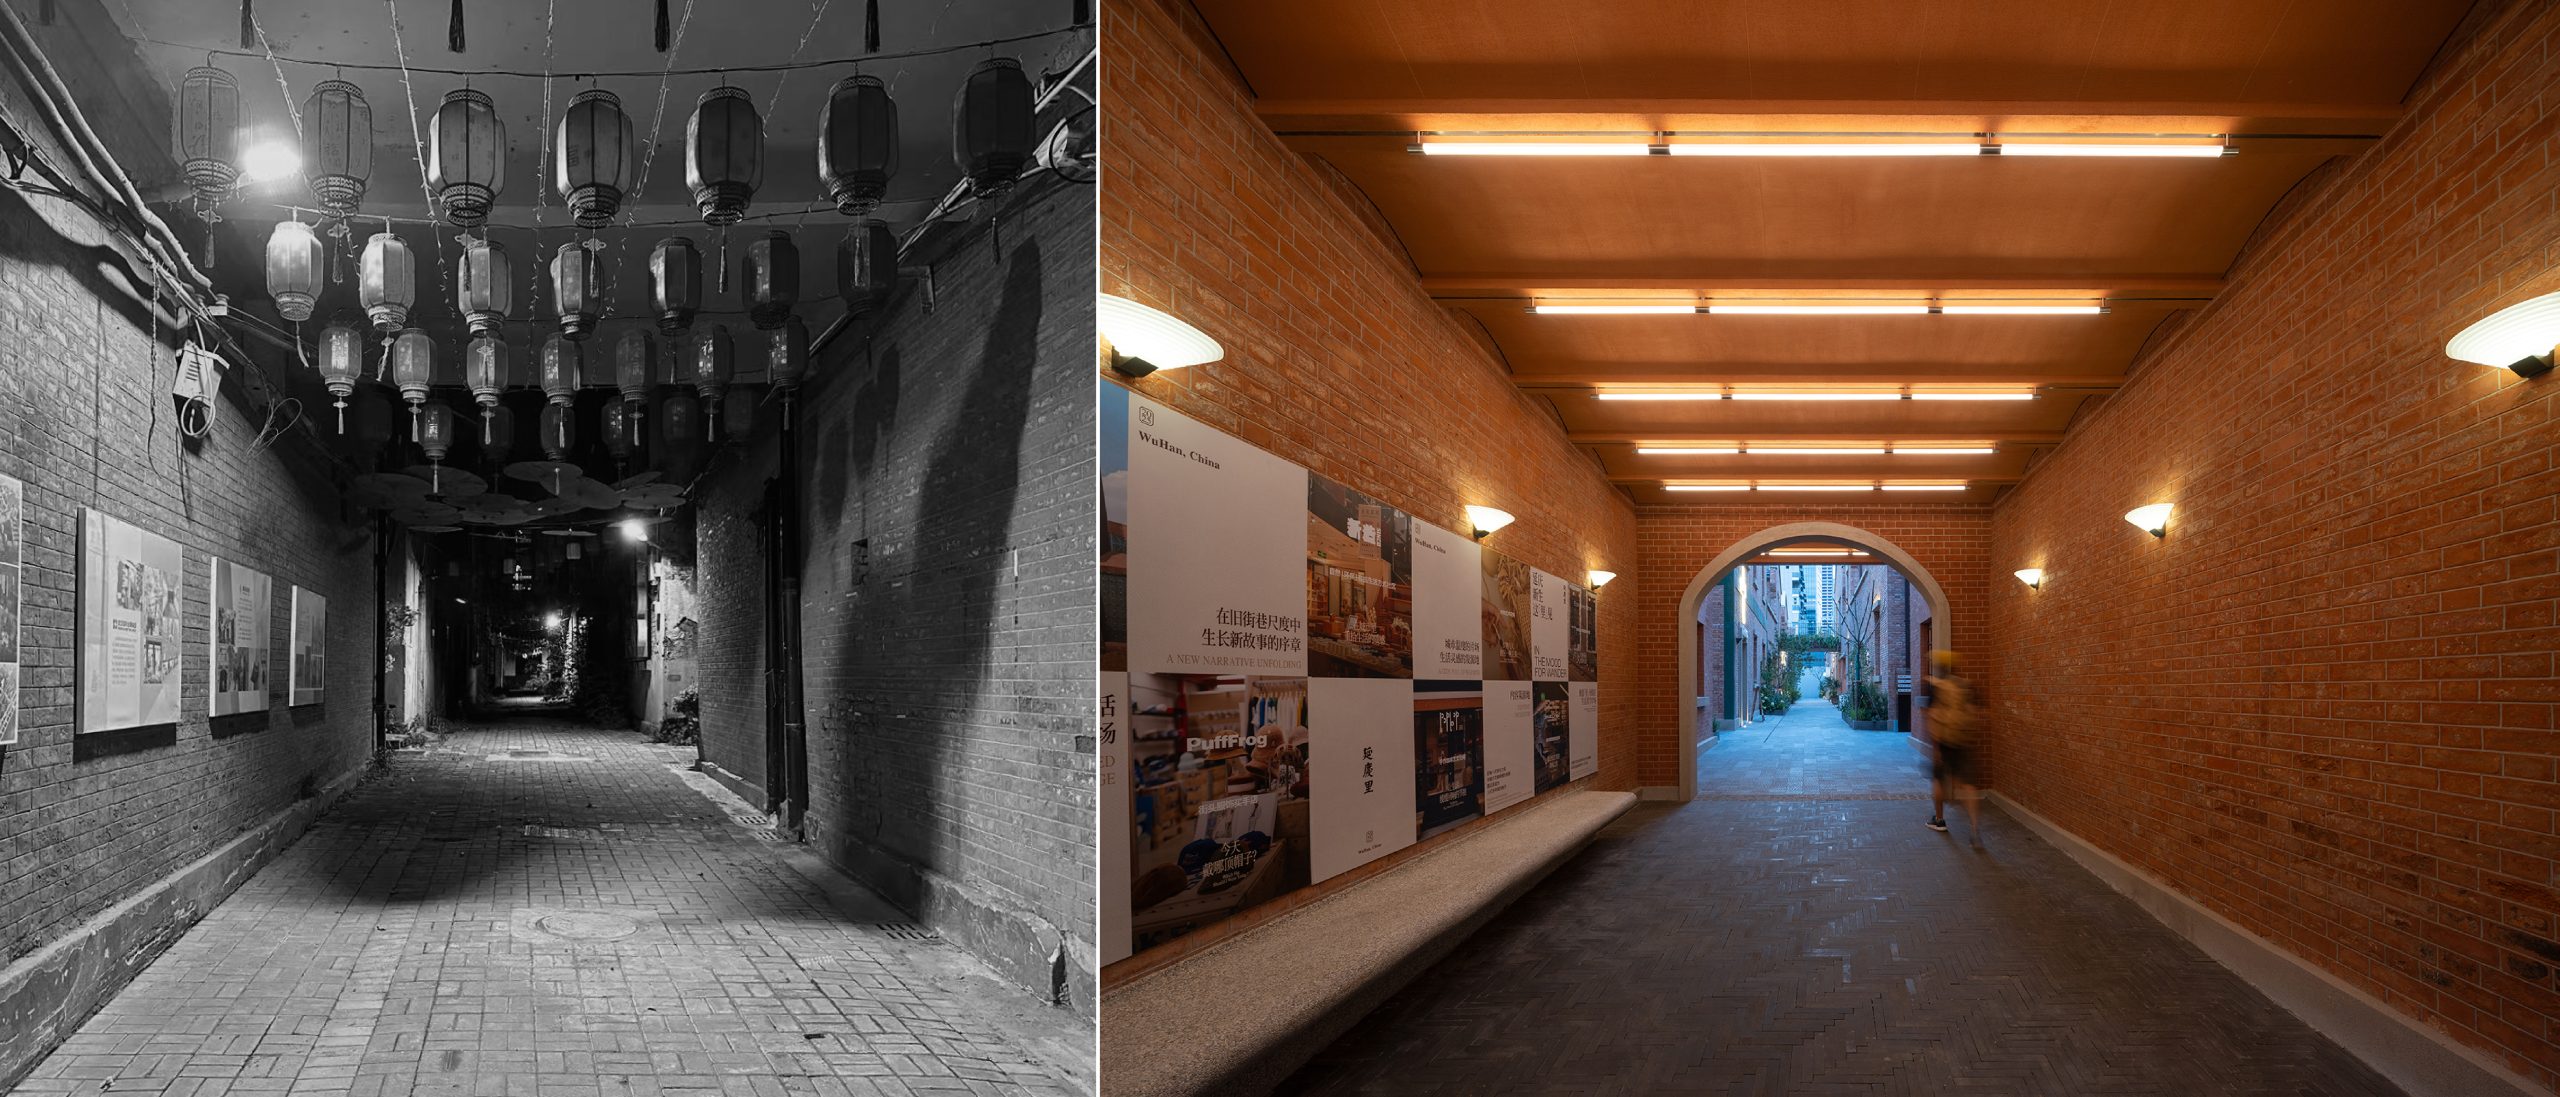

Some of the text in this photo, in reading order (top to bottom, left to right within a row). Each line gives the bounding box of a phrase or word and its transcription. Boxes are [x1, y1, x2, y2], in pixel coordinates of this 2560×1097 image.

[1138, 430, 1220, 470] WuHan, China
[1216, 606, 1301, 633] 在旧街巷尺度中
[1201, 628, 1301, 653] 生长新故事的序章
[1534, 645, 1540, 655] IN
[1166, 654, 1302, 669] A NEW NARRATIVE UNFOLDING
[1535, 667, 1546, 678] FOR
[1186, 734, 1268, 752] PuffFrog
[1221, 840, 1240, 857] 今天
